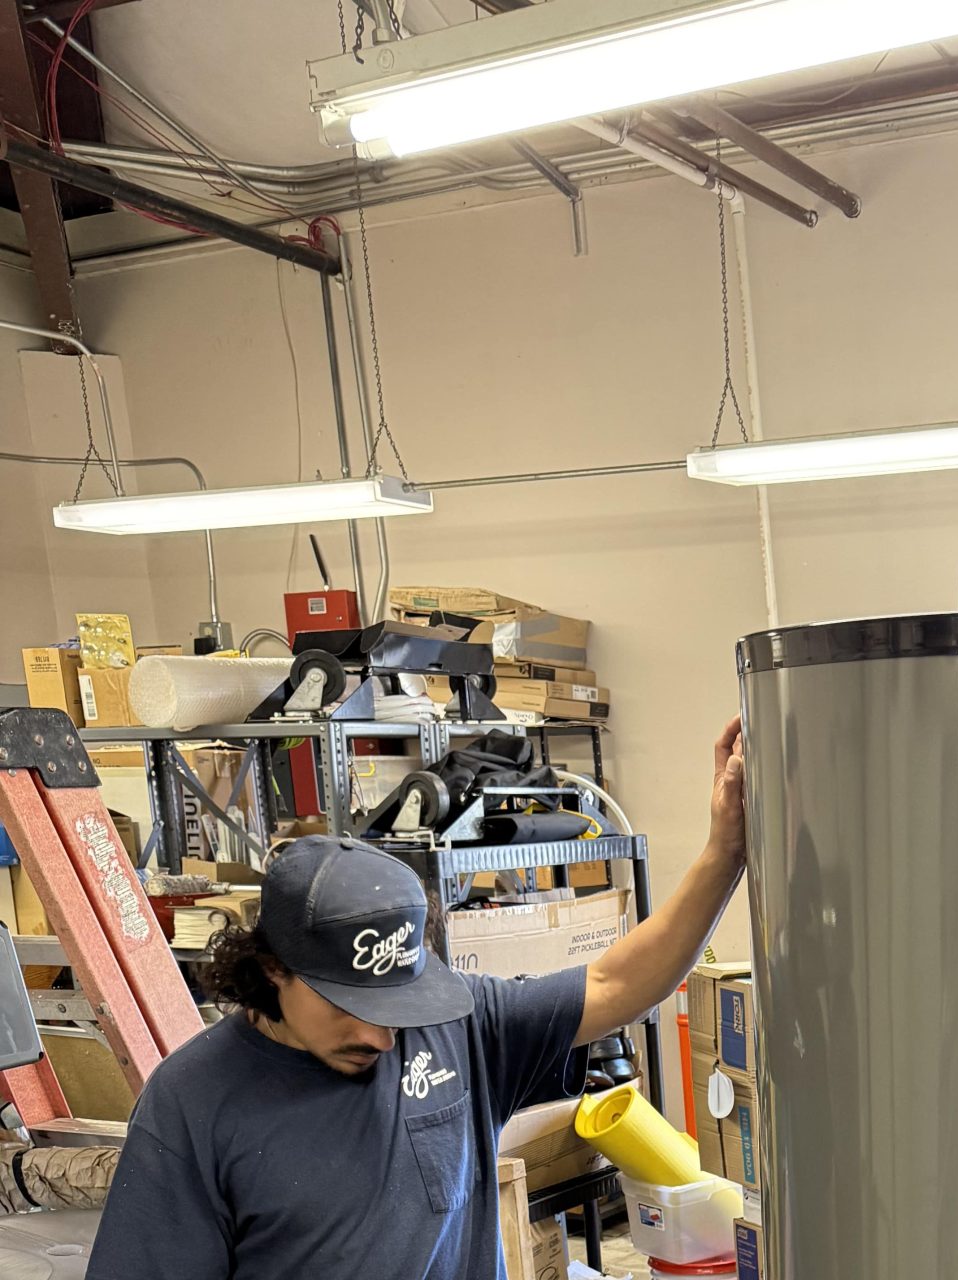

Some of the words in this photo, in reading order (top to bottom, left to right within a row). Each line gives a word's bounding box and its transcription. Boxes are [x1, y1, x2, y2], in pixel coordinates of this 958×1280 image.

[571, 932, 590, 945] INDOOR
[596, 927, 618, 939] OUTDOOR
[352, 921, 416, 976] Eager
[581, 940, 609, 953] PICKLEBALL
